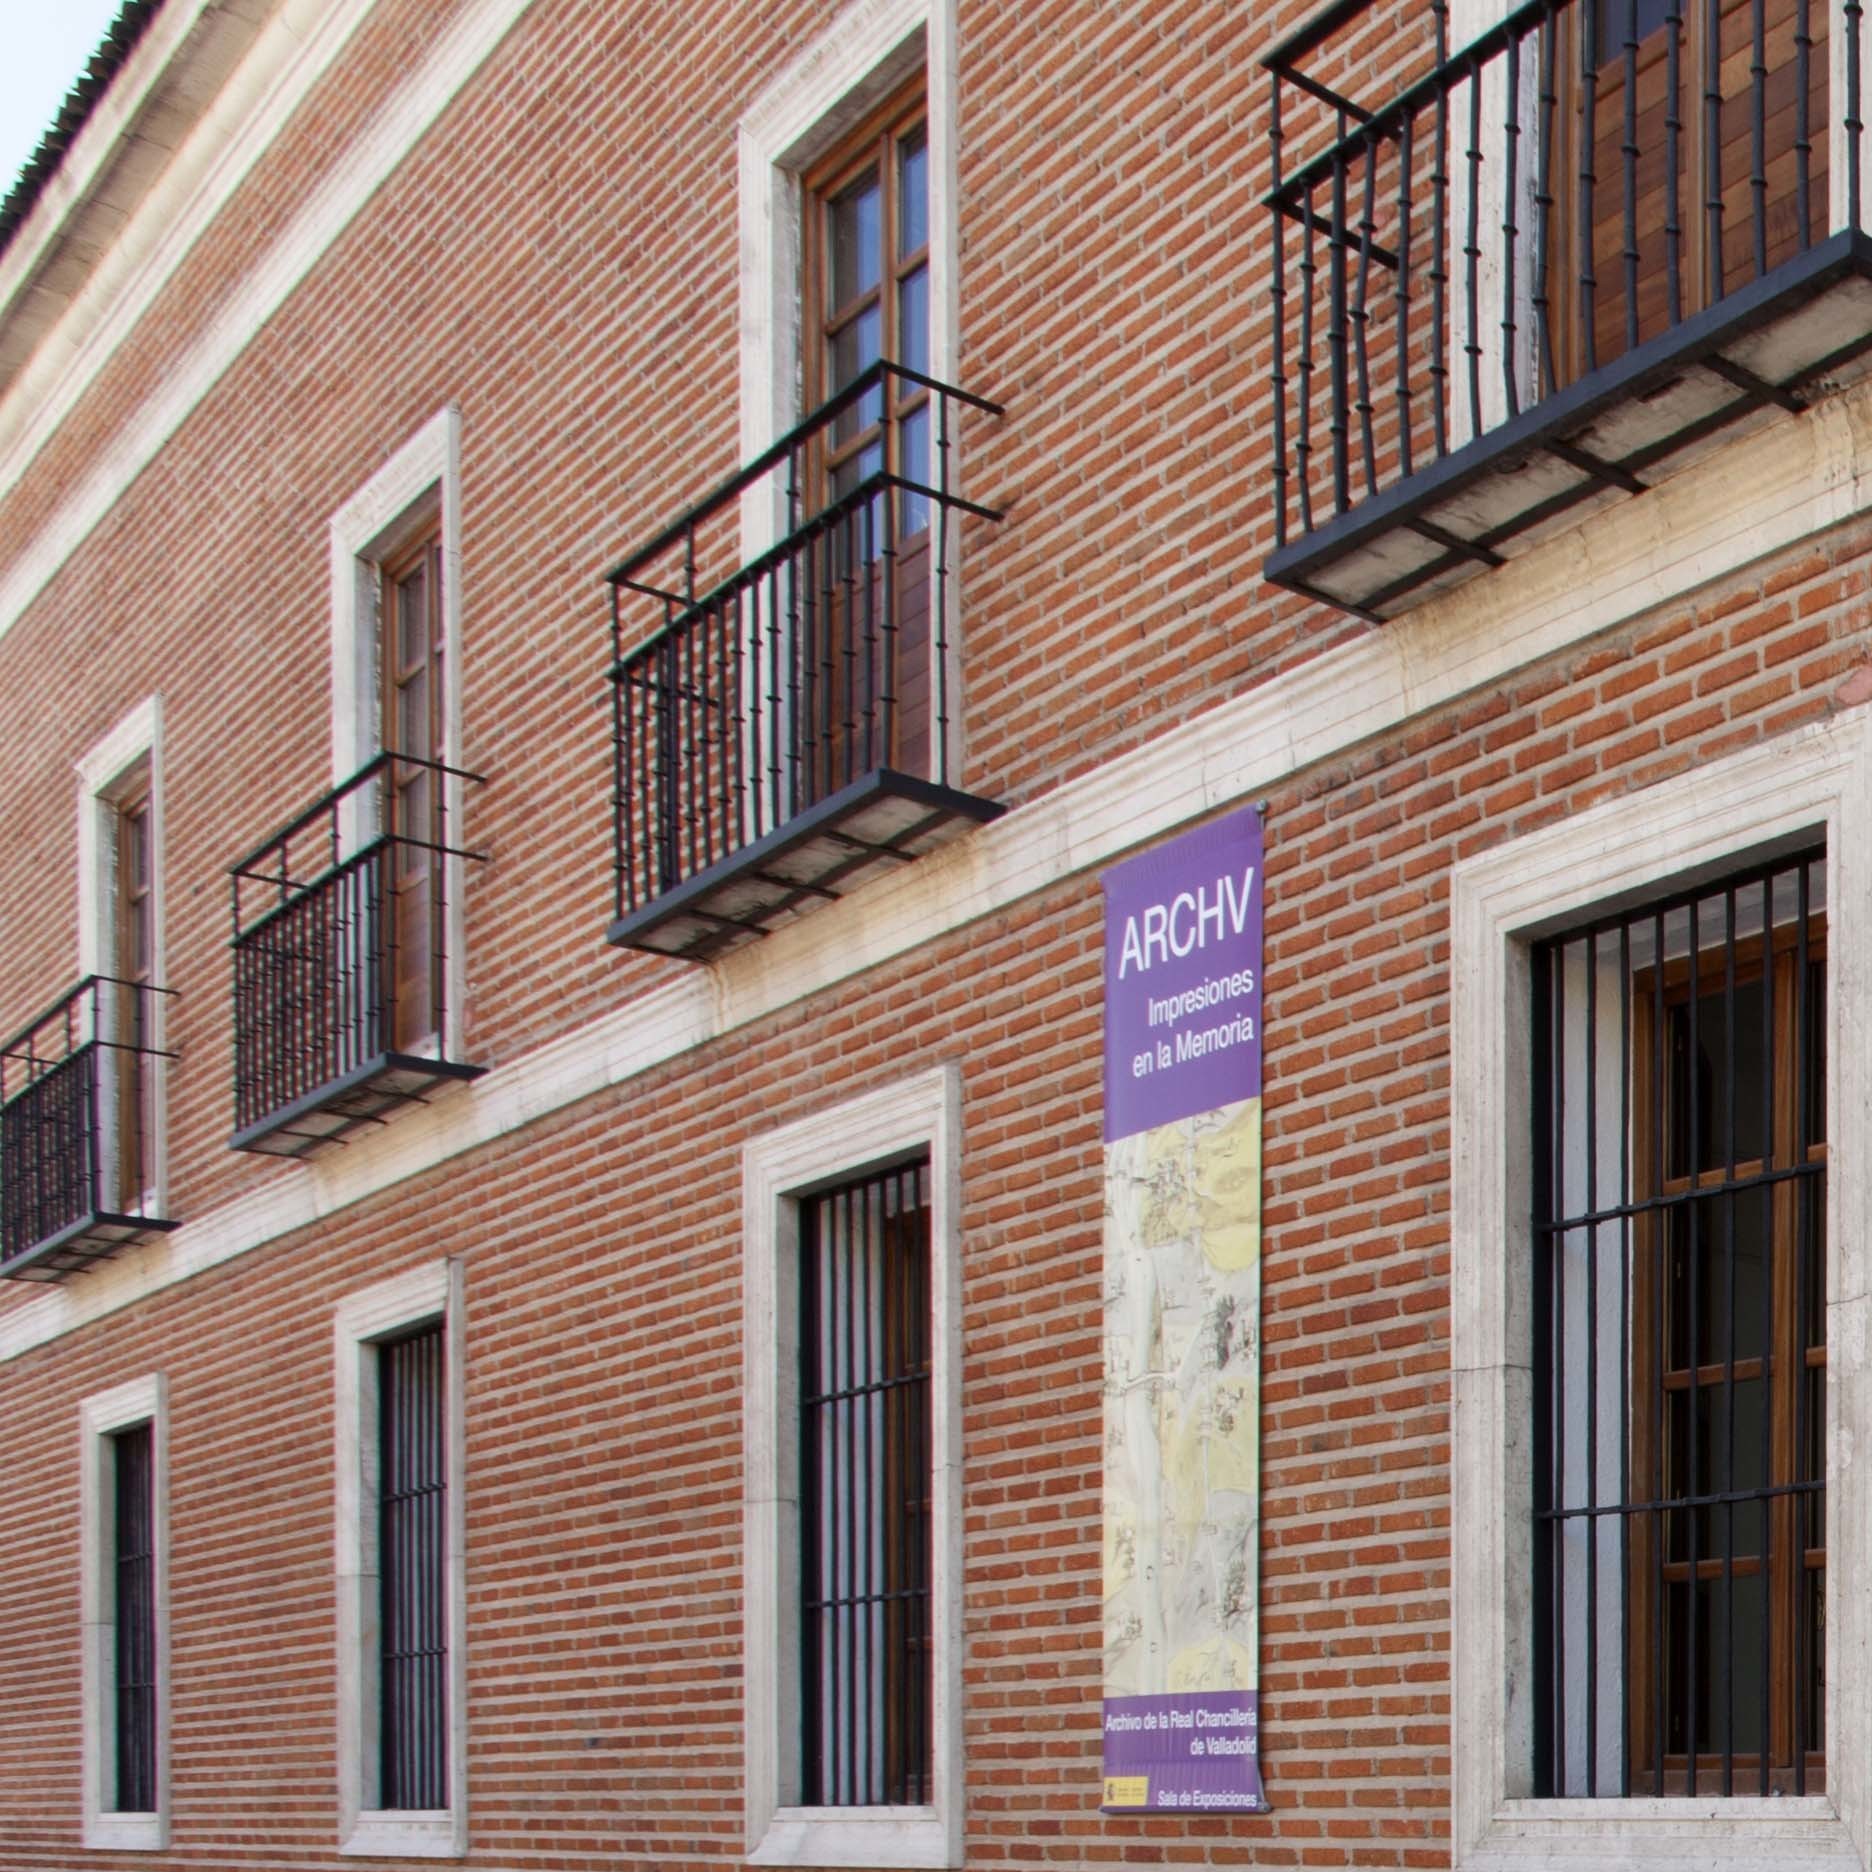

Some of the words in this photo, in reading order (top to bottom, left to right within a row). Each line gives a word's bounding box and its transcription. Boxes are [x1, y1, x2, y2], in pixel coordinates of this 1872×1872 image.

[1118, 867, 1254, 980] ARCHV
[1149, 969, 1254, 1027] Impresiones
[1133, 1050, 1152, 1078] en
[1158, 1041, 1171, 1069] la
[1176, 1014, 1254, 1065] Memoria
[1105, 1713, 1142, 1731] Archivo
[1144, 1712, 1157, 1729] de
[1159, 1712, 1169, 1729] la
[1170, 1710, 1193, 1728] Real
[1190, 1737, 1204, 1755] de
[1206, 1736, 1257, 1755] Valladolid
[1157, 1790, 1177, 1806] Sala
[1179, 1791, 1191, 1806] de
[1193, 1790, 1257, 1809] Exposiciones
